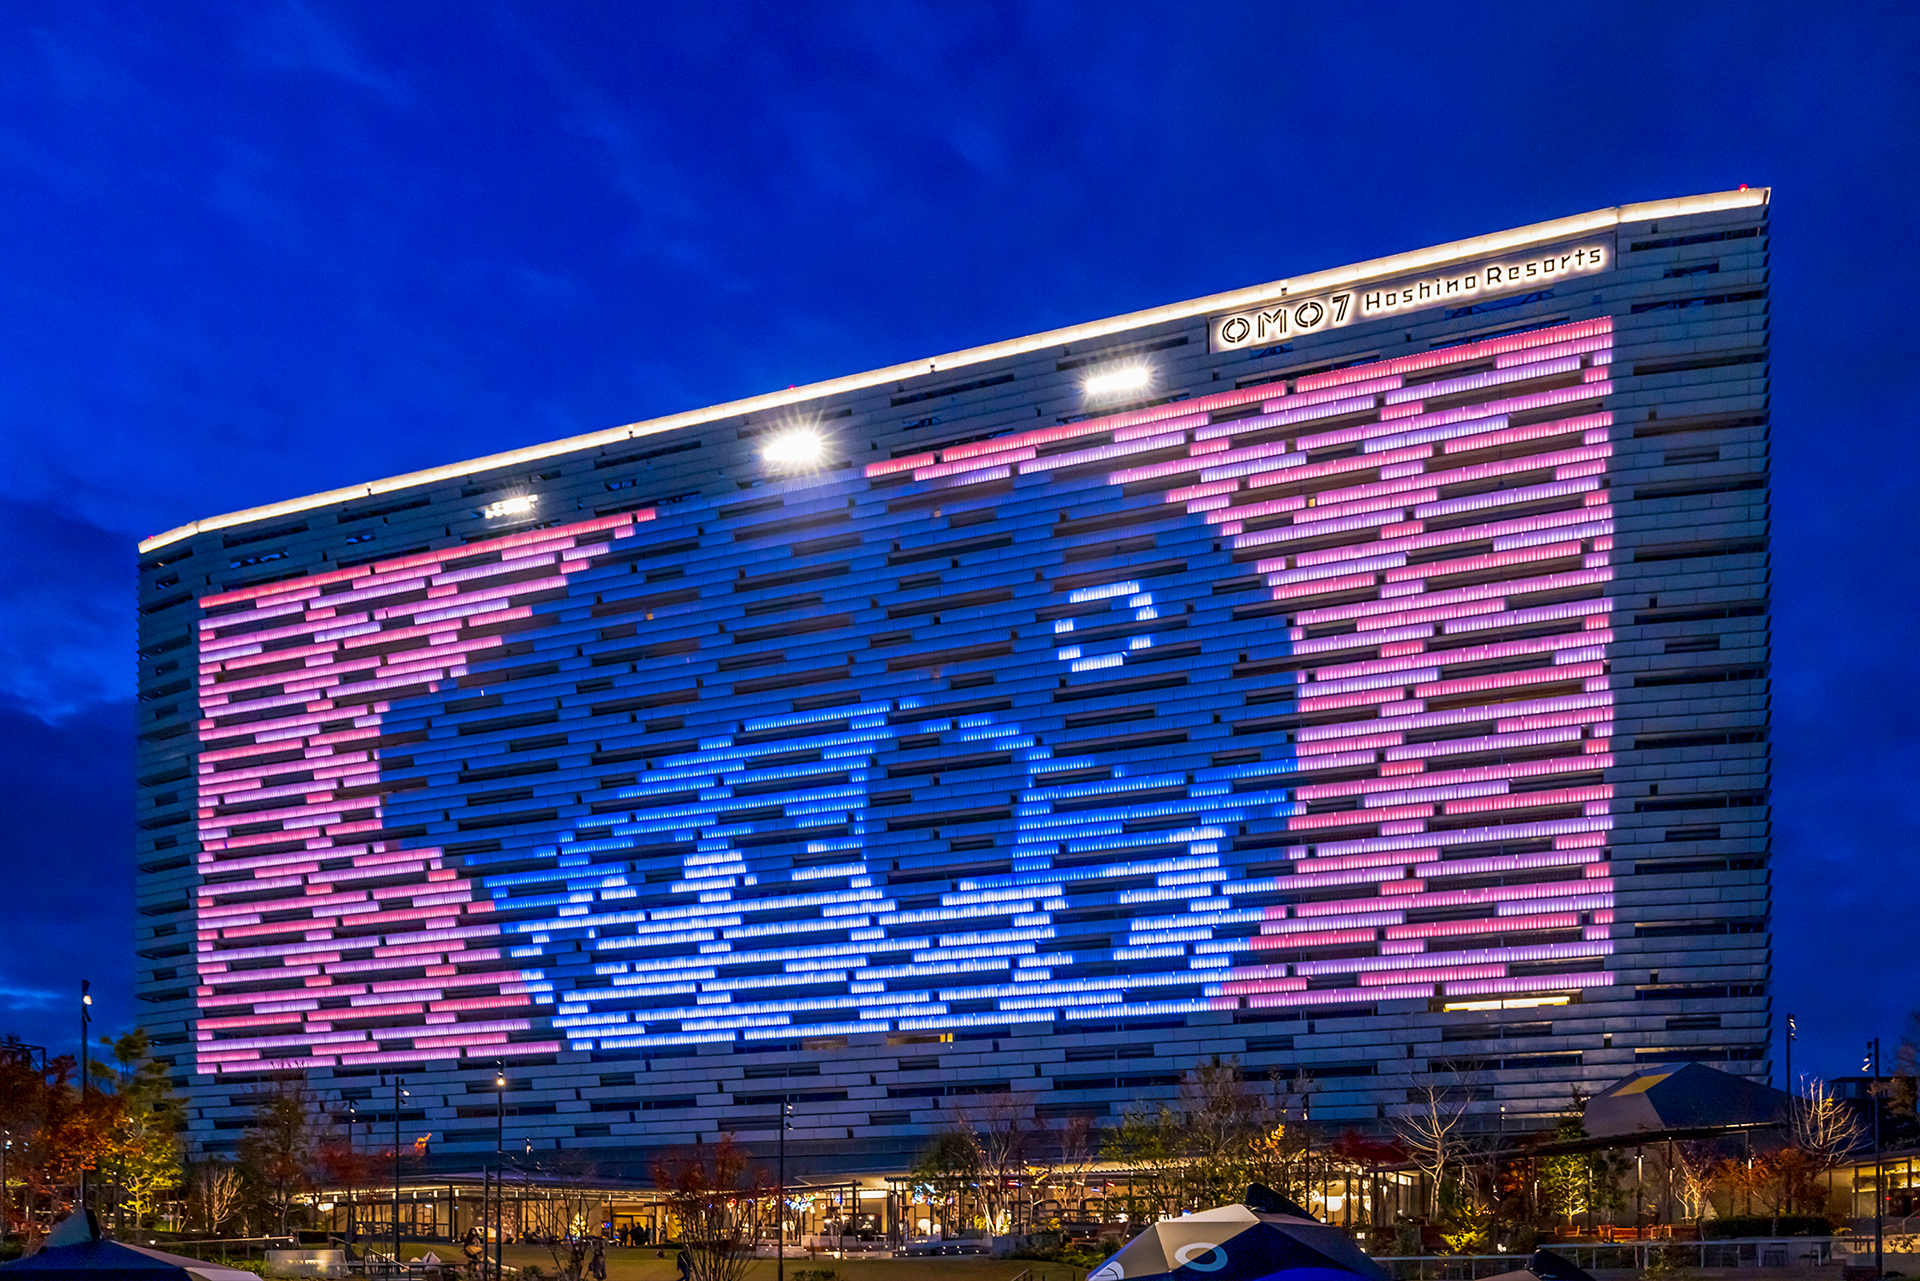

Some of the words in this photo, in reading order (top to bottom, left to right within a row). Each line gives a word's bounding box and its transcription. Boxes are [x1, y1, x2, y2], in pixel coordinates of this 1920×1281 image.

[1222, 293, 1352, 343] OMO7
[1365, 274, 1477, 312] Hoshino
[1486, 247, 1602, 286] Resorts
